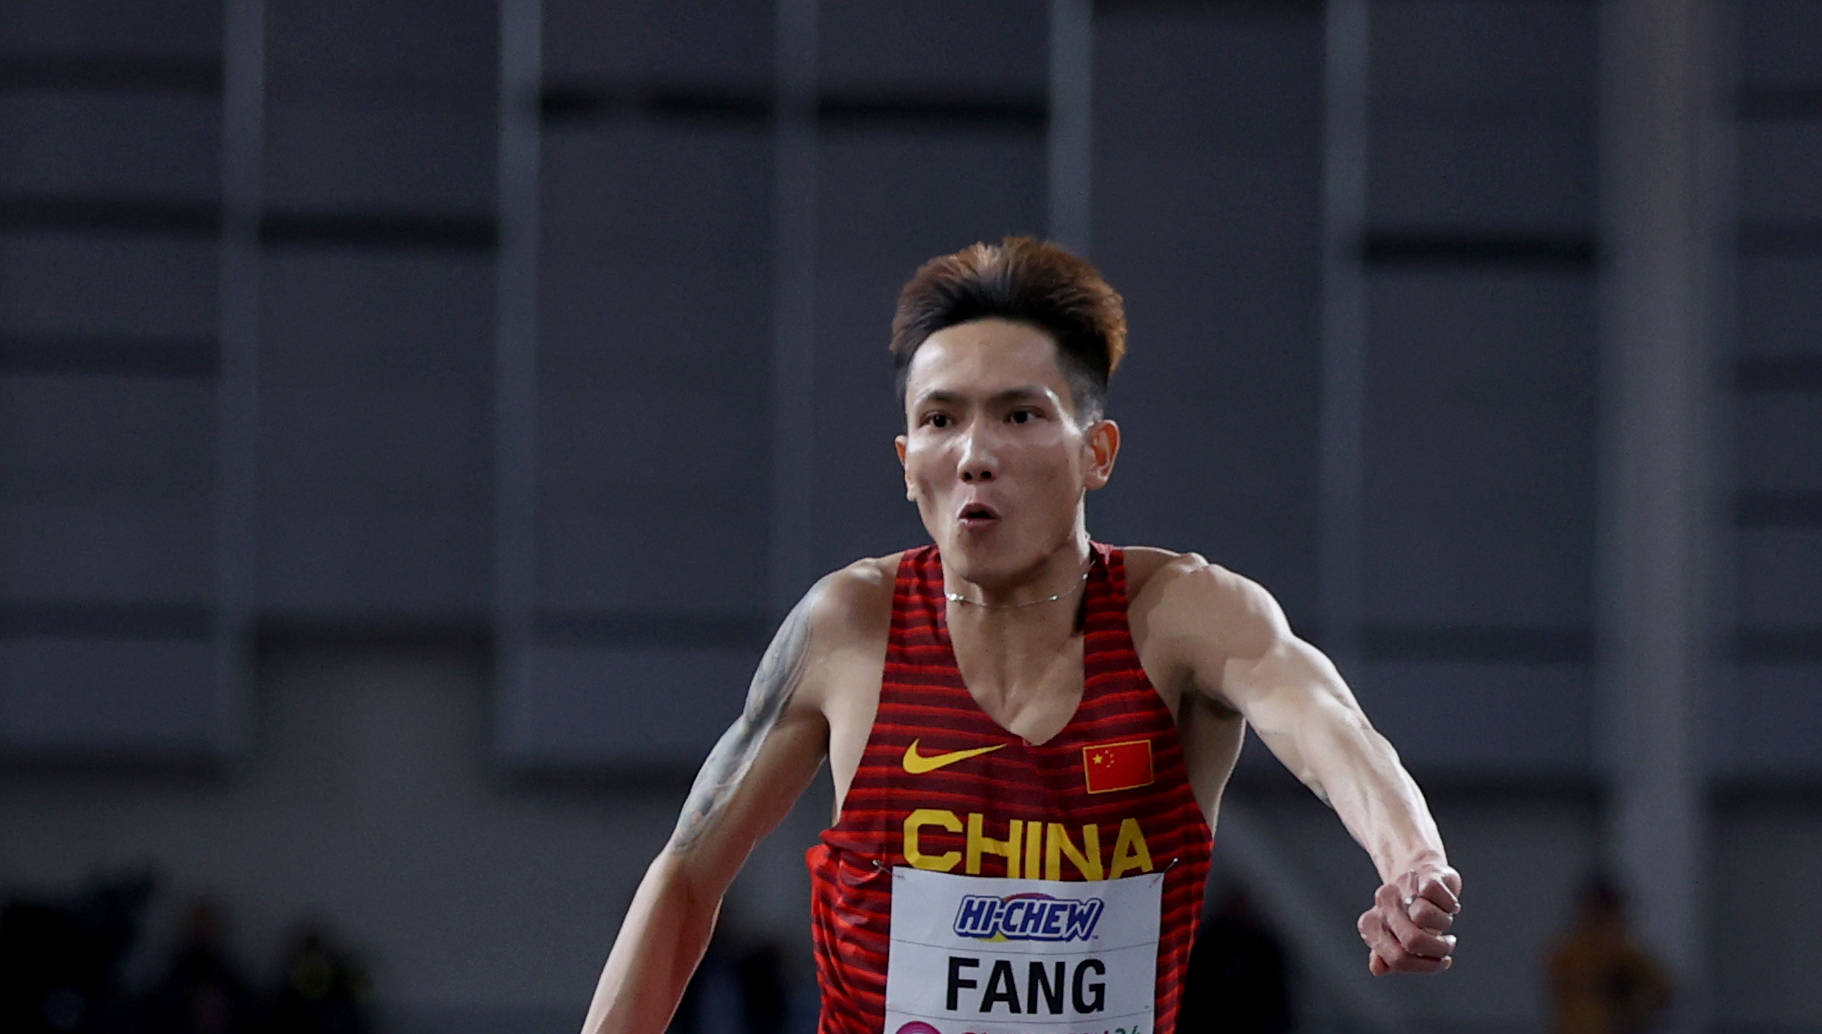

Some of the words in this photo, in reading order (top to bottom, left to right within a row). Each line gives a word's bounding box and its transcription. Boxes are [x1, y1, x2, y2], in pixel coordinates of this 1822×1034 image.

[903, 808, 1154, 882] CHINA
[954, 895, 1104, 942] HI-CHEW
[945, 956, 1106, 1015] FANG
